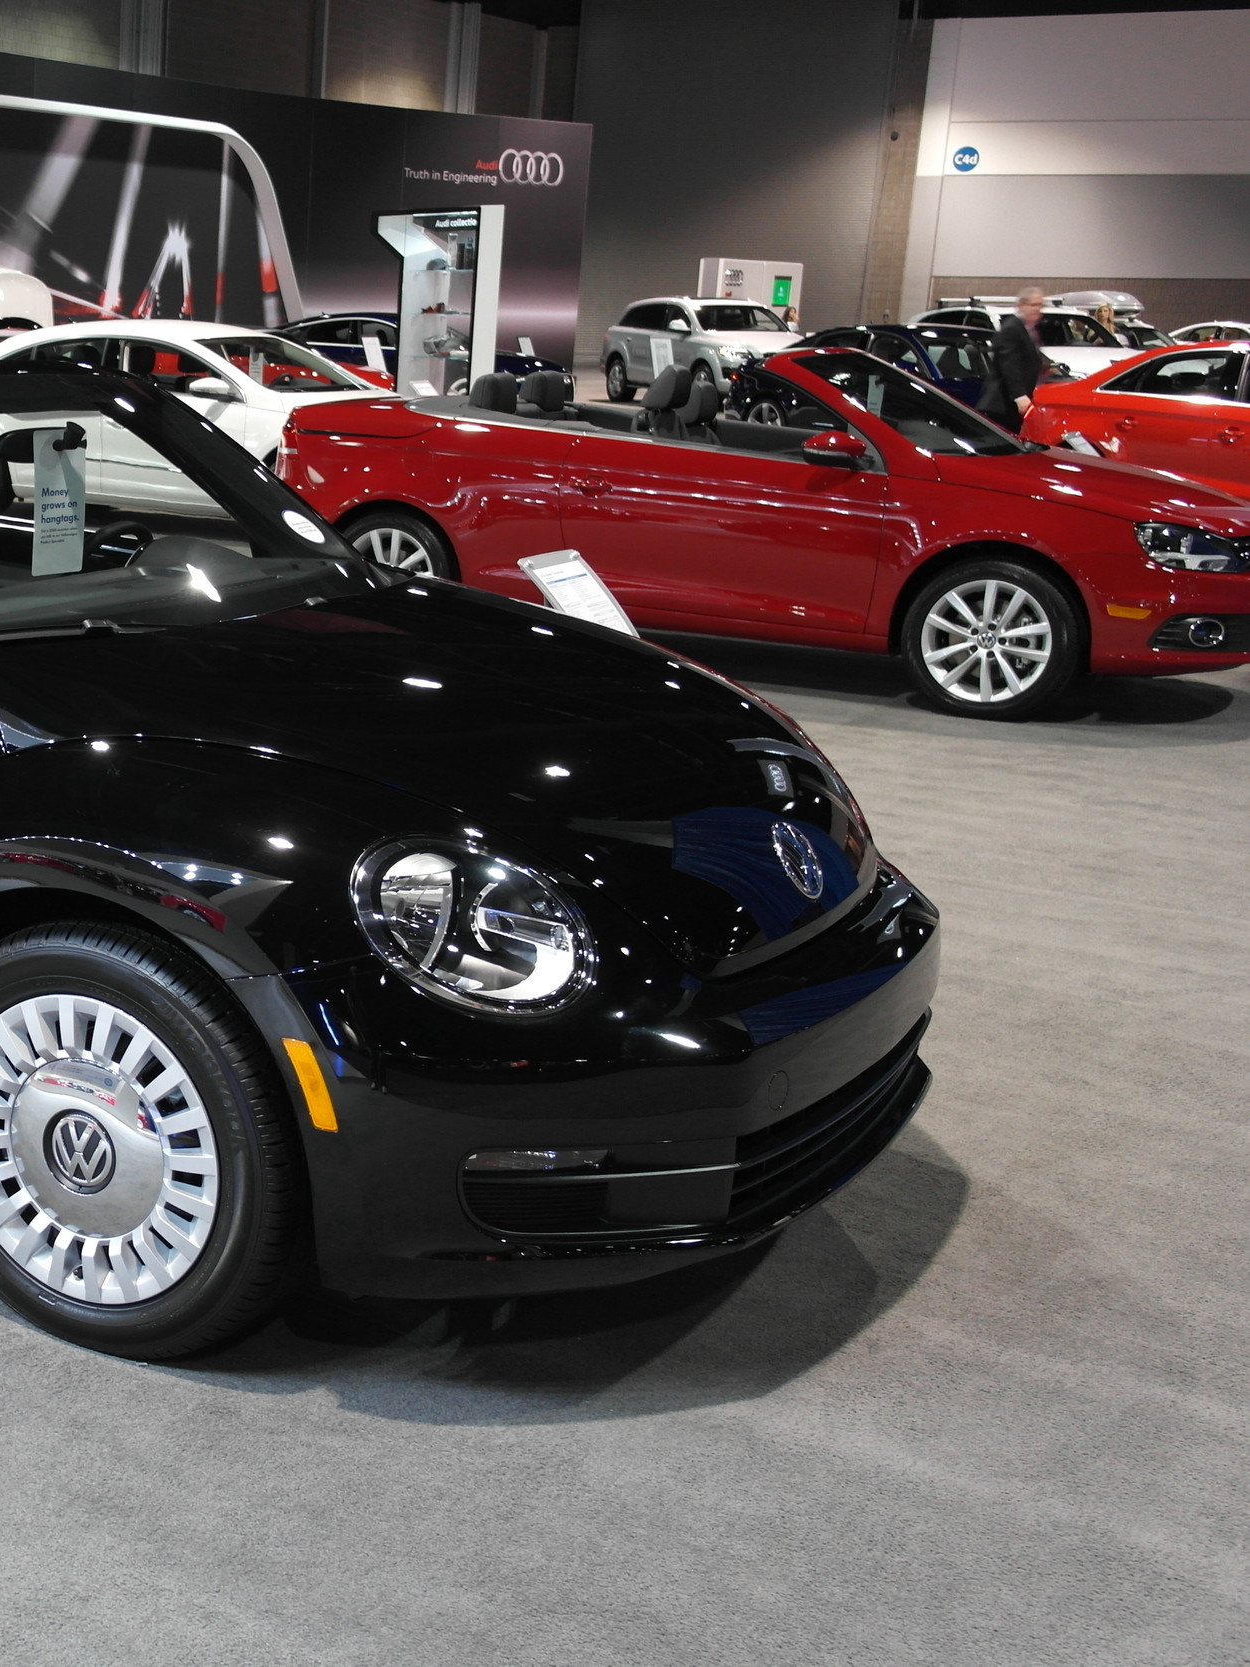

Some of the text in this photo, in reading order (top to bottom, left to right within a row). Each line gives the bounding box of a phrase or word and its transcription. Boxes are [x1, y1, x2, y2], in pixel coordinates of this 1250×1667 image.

[954, 153, 978, 165] C4d
[475, 159, 498, 171] Audi
[404, 167, 498, 186] Truth in Engineering
[435, 218, 450, 228] Audi
[41, 487, 69, 497] Money
[41, 502, 65, 512] grows
[40, 515, 80, 525] hangtags.
[52, 1114, 113, 1188] VW
